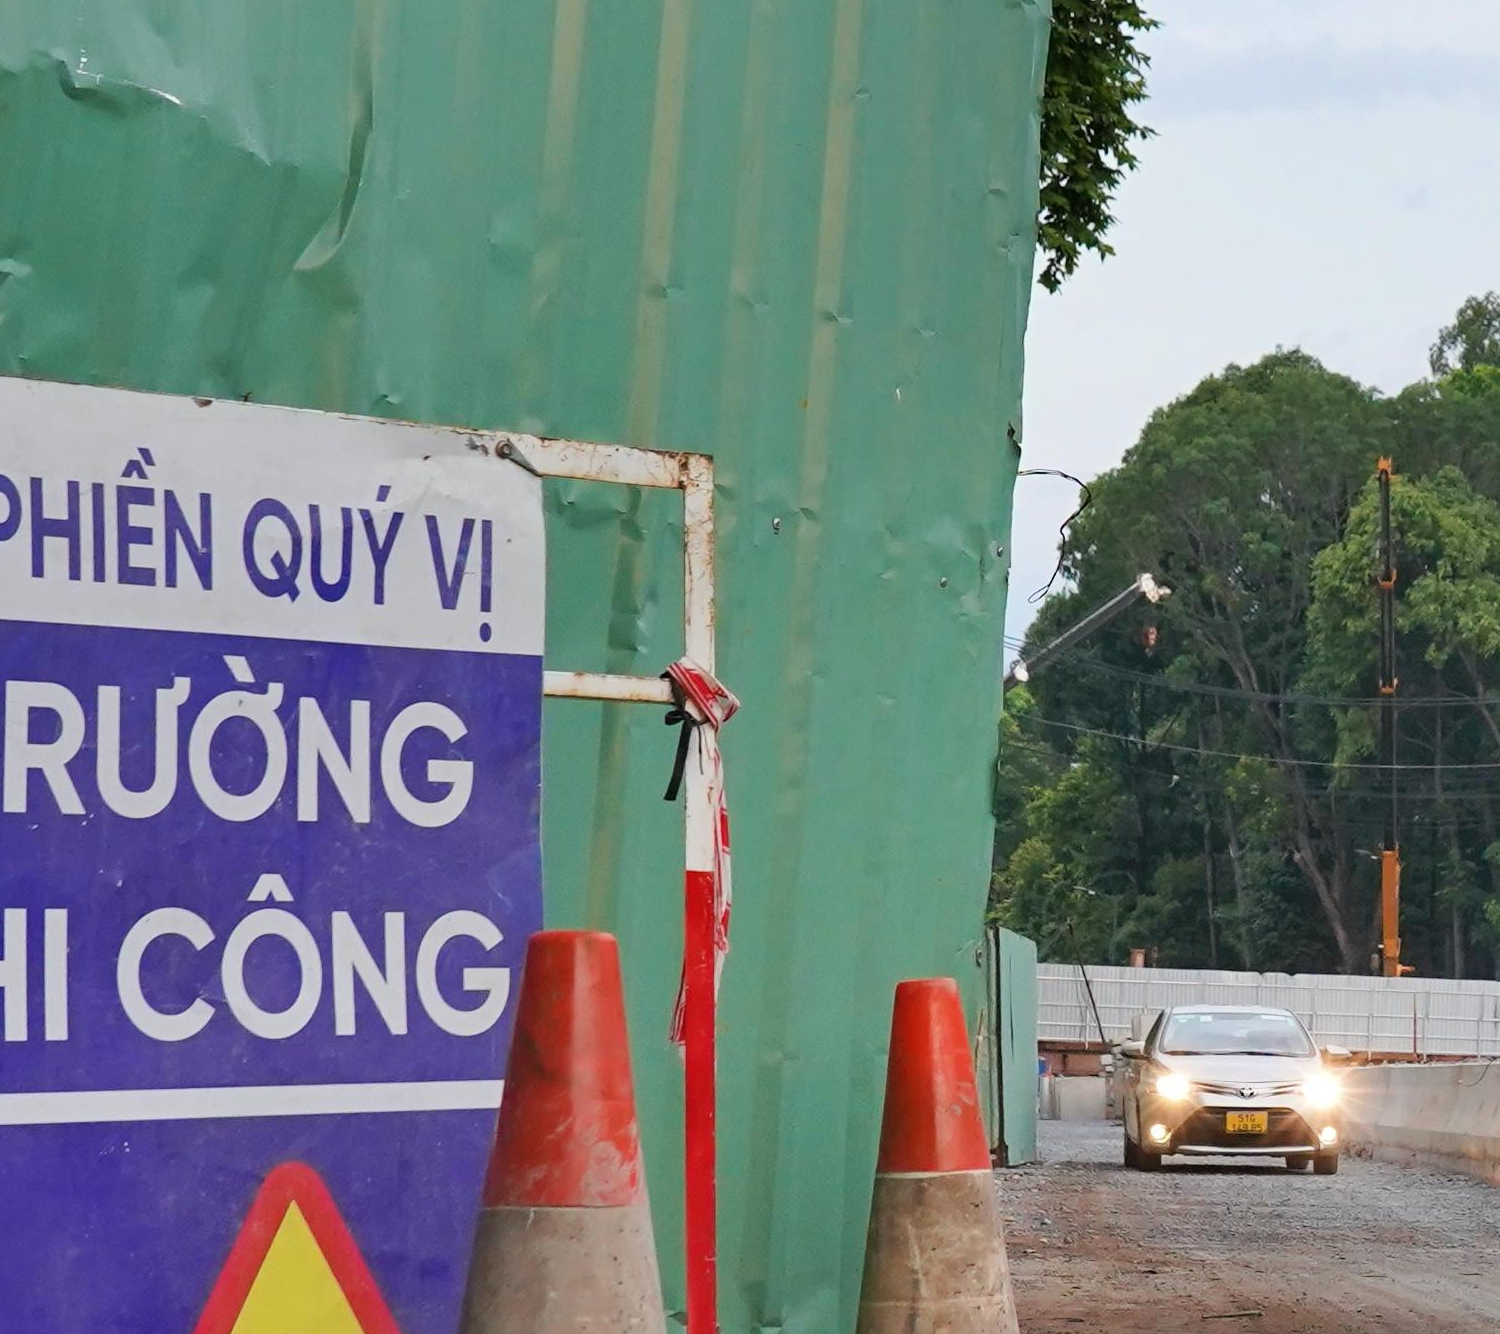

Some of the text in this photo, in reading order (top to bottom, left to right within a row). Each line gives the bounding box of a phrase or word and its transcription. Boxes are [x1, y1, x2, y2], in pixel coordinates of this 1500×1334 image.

[242, 484, 403, 605] QUÝ
[426, 515, 494, 642] VỊ
[117, 873, 510, 1042] CÔNG
